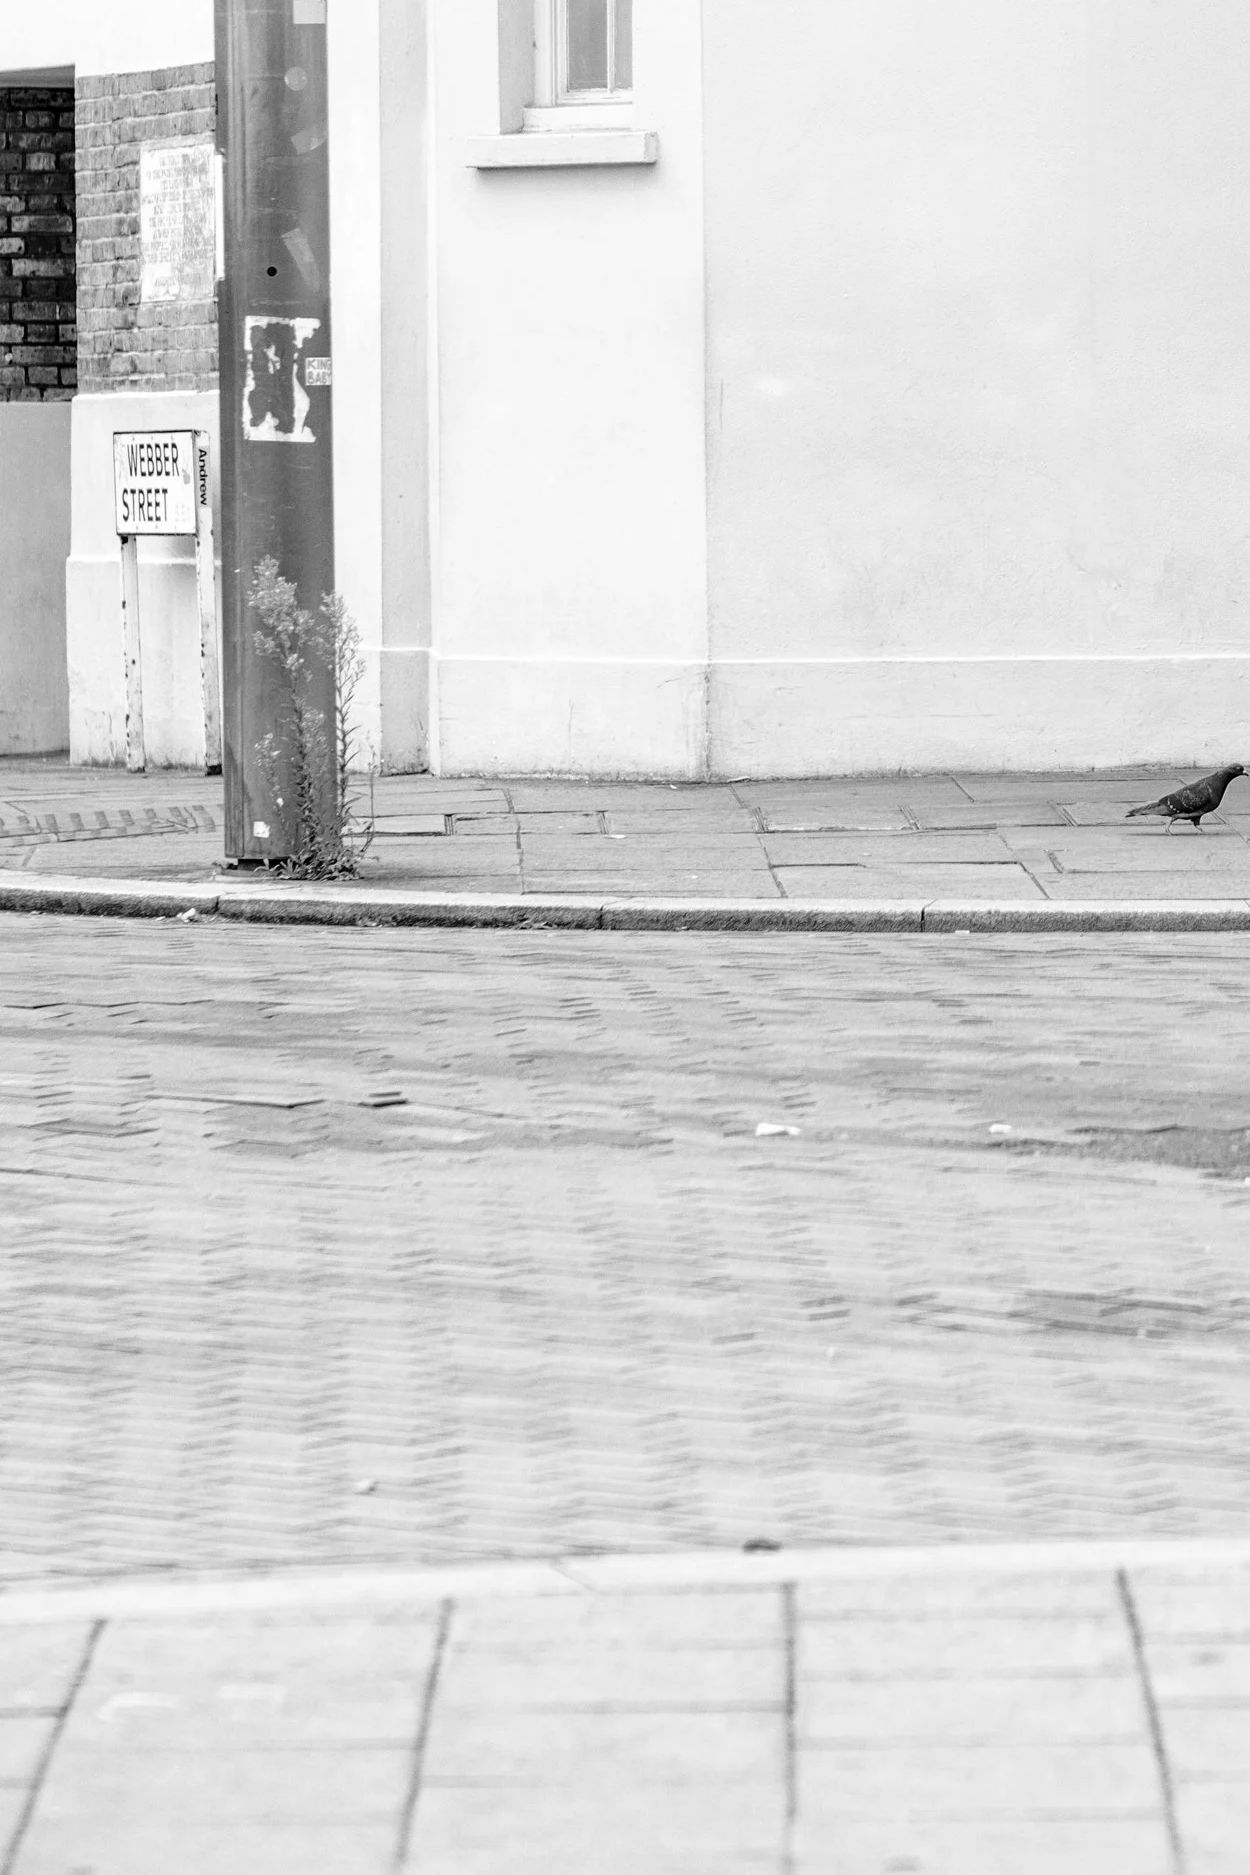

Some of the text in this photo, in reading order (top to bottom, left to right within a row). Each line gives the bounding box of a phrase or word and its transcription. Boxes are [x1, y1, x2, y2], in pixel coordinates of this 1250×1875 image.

[127, 442, 180, 477] WEBBER
[198, 448, 208, 506] Andrew
[121, 487, 169, 522] STREET
